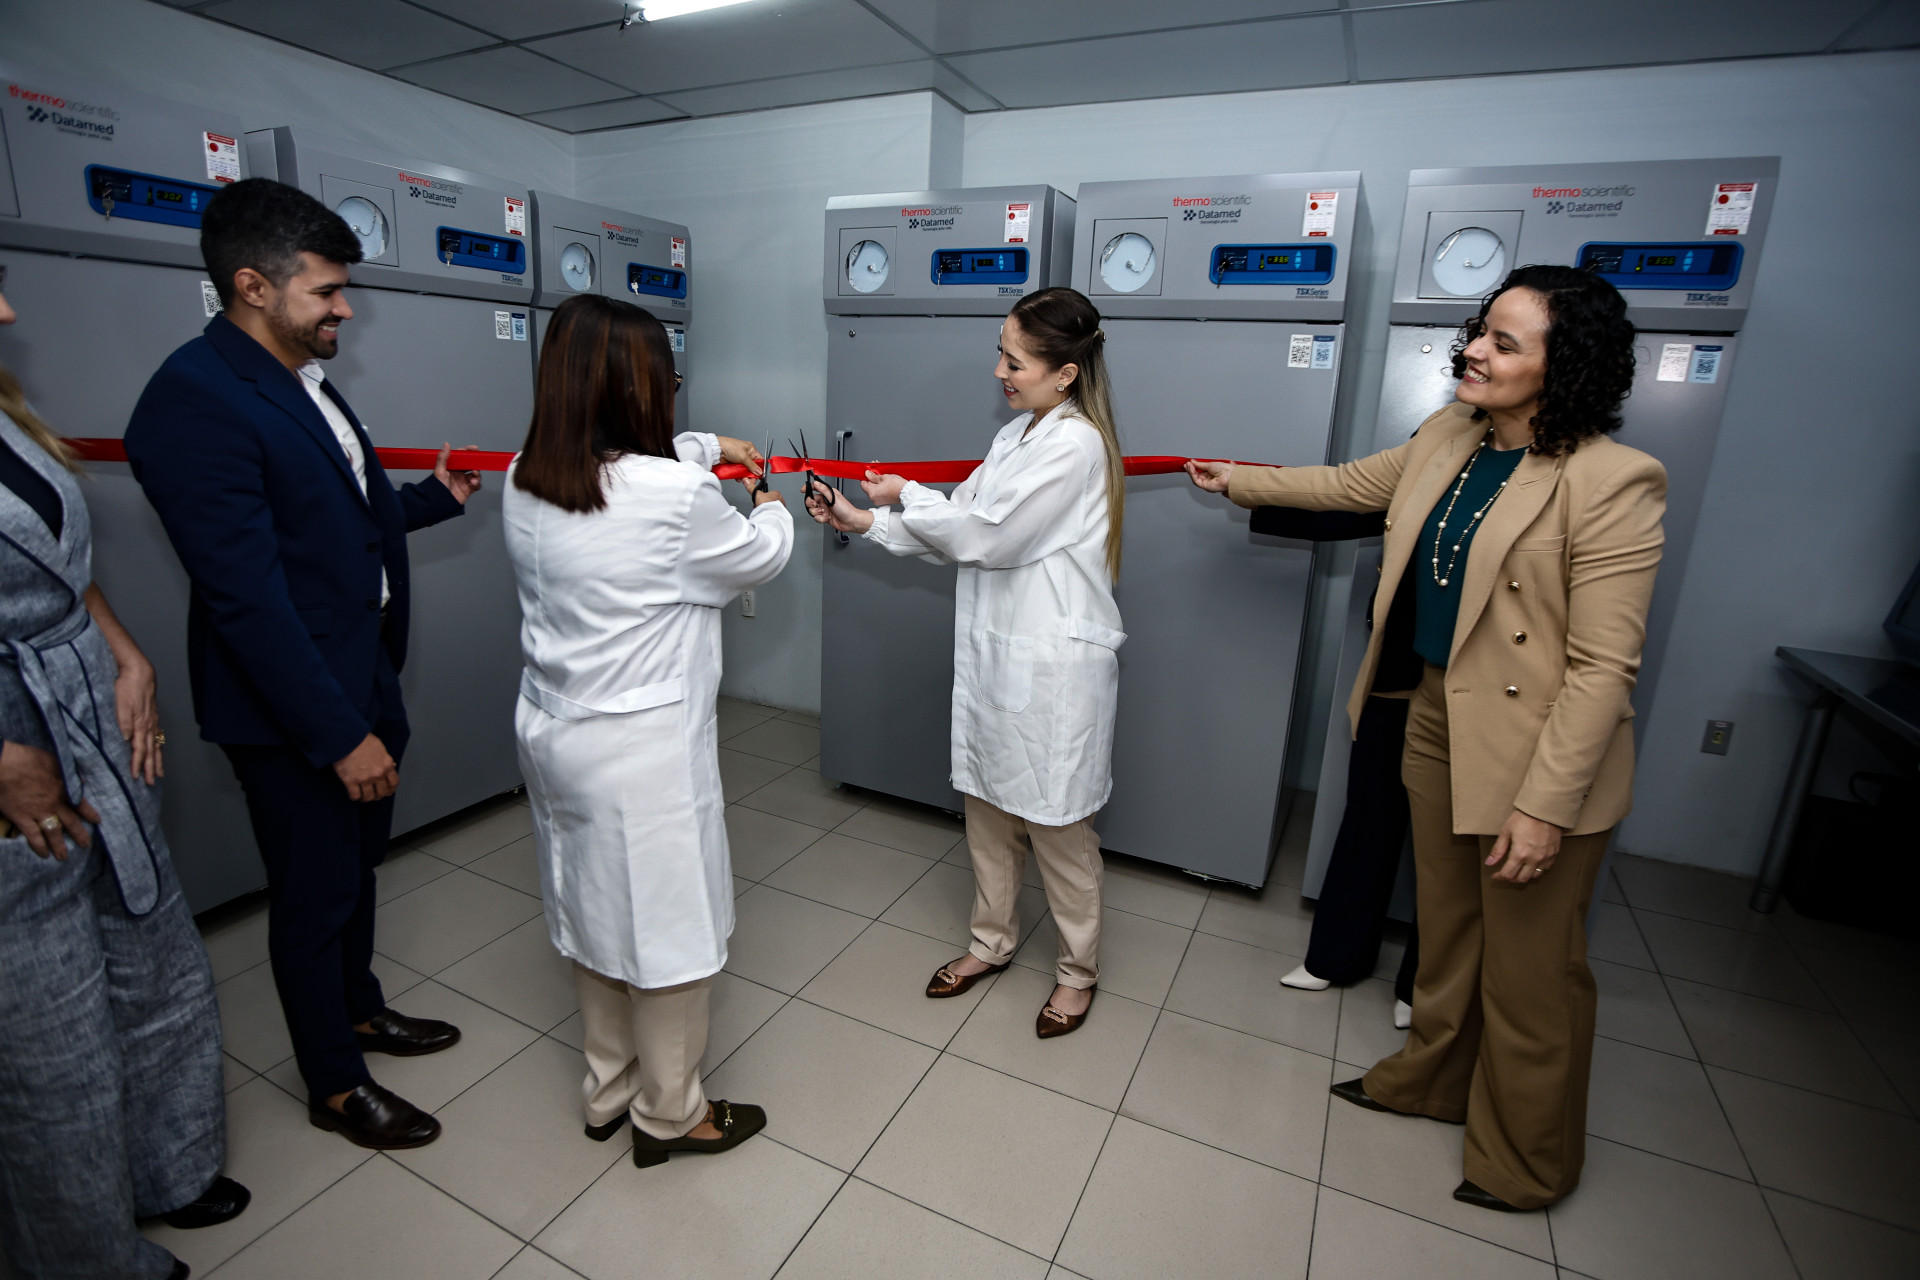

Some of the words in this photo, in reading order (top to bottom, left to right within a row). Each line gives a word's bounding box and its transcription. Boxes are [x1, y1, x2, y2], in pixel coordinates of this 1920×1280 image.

[51, 111, 114, 135] Datamed
[422, 189, 456, 204] Datamed
[1566, 200, 1623, 213] Datamed
[1198, 208, 1241, 219] Datamed
[921, 217, 954, 227] Datamed
[616, 233, 638, 244] Datamed
